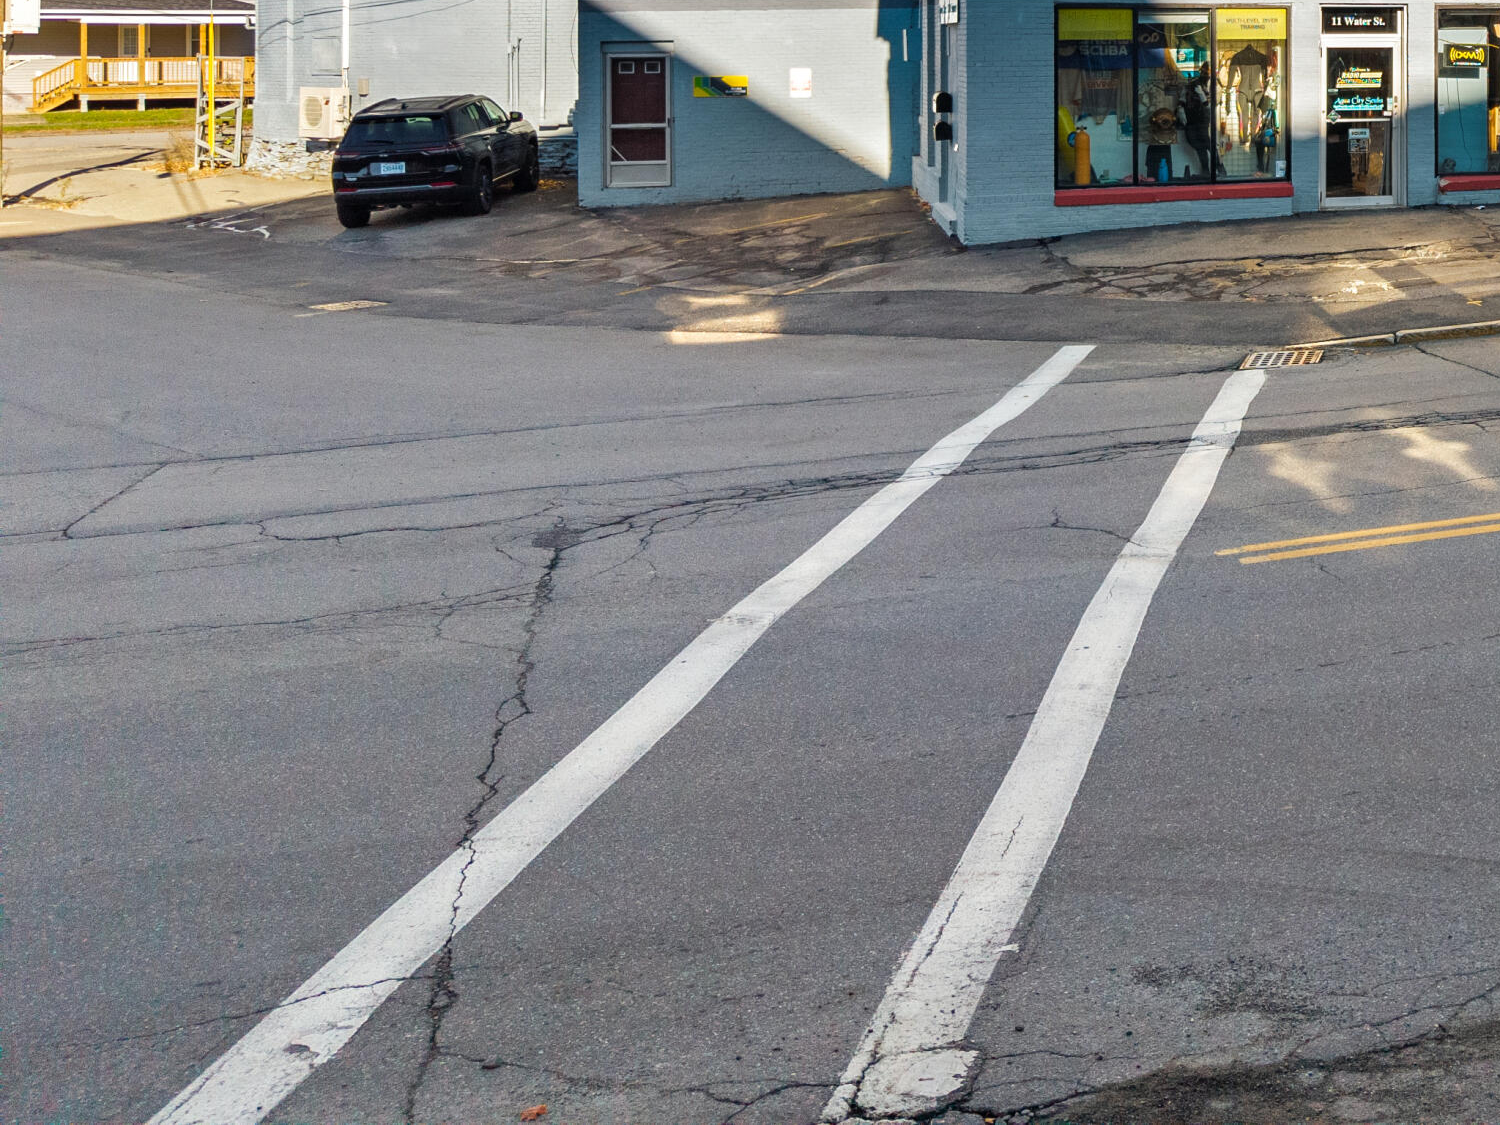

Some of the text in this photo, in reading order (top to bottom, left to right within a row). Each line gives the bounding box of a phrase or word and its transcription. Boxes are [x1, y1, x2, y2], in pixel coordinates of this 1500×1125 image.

[1331, 16, 1386, 26] 11 Water St.
[1079, 44, 1129, 56] SCUBA
